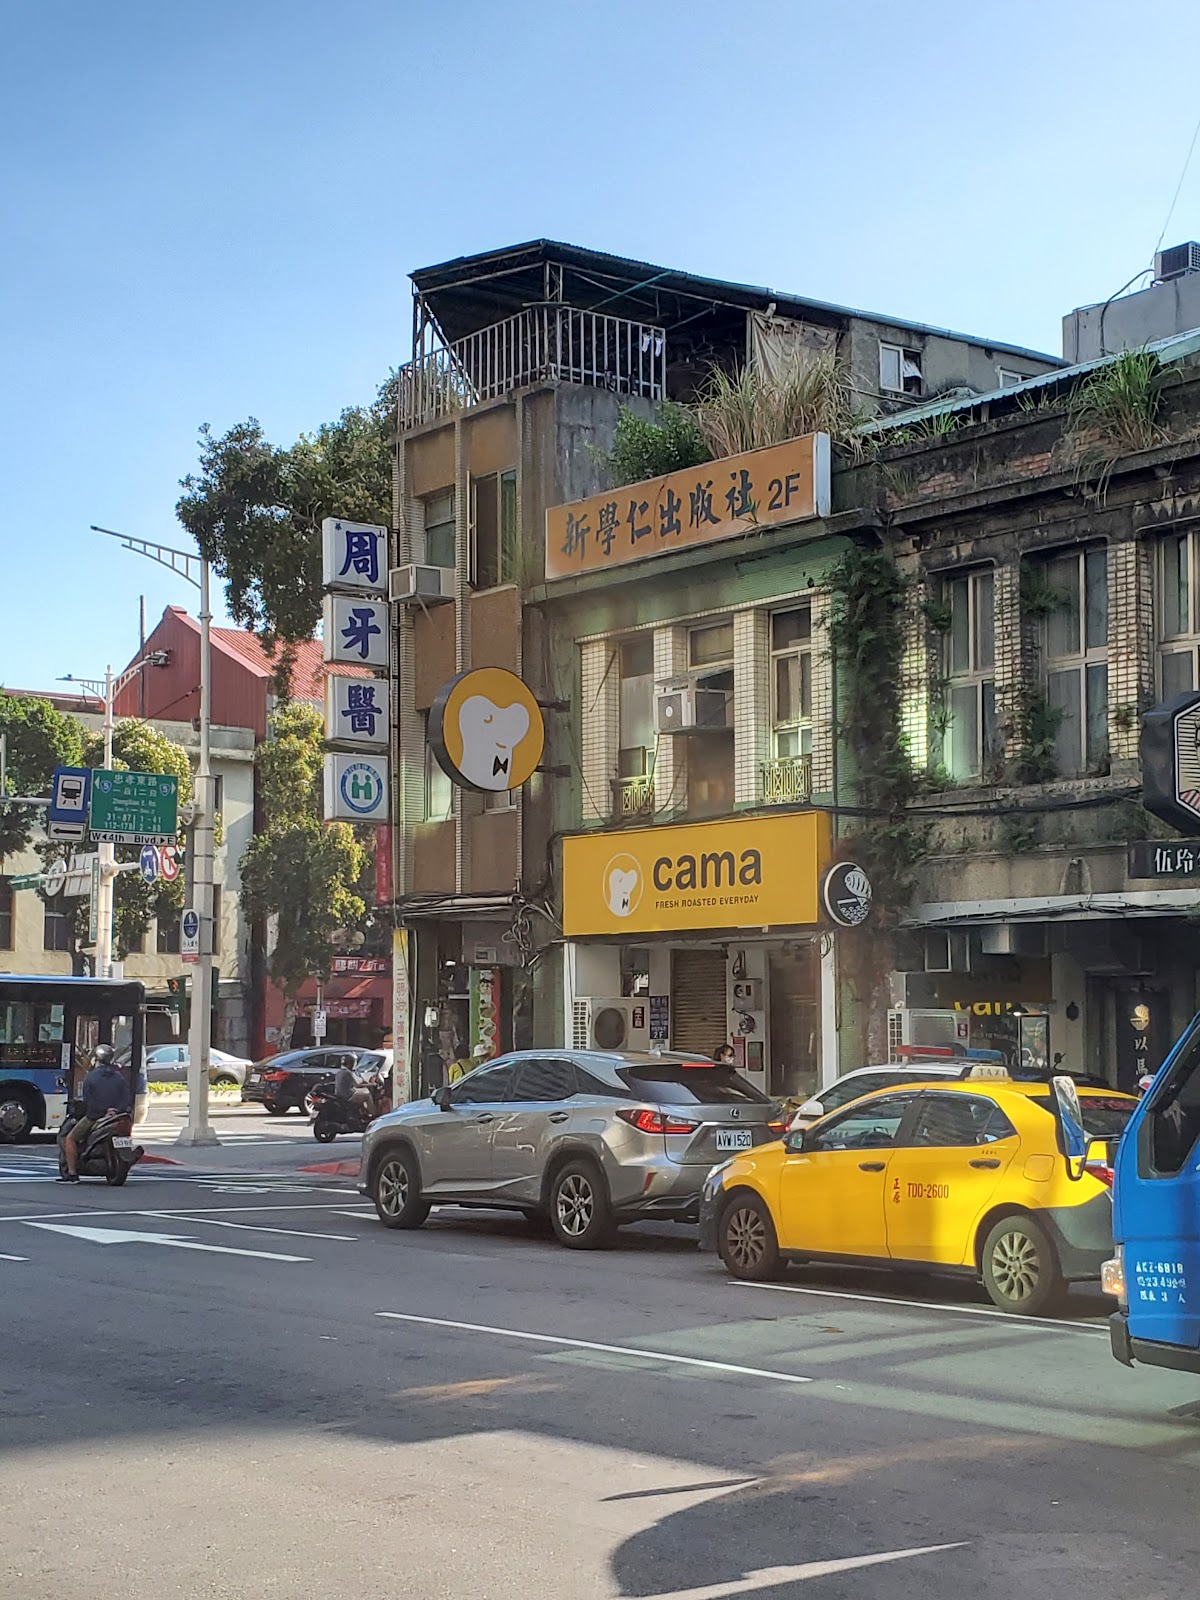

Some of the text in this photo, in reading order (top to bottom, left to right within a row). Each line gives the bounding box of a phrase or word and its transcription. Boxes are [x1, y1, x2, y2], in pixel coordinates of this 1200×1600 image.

[561, 469, 801, 561] 新學仁出版社 2F
[114, 775, 157, 787] 忠孝東路
[104, 821, 133, 830] 112-178
[92, 832, 102, 841] W
[109, 834, 125, 842] 4th
[134, 835, 159, 844] Blvd.
[1154, 847, 1200, 874] 伍玲
[653, 848, 762, 892] cama
[655, 894, 759, 909] FRESH ROASTED EVERYDAY
[978, 1069, 1006, 1077] TAXI
